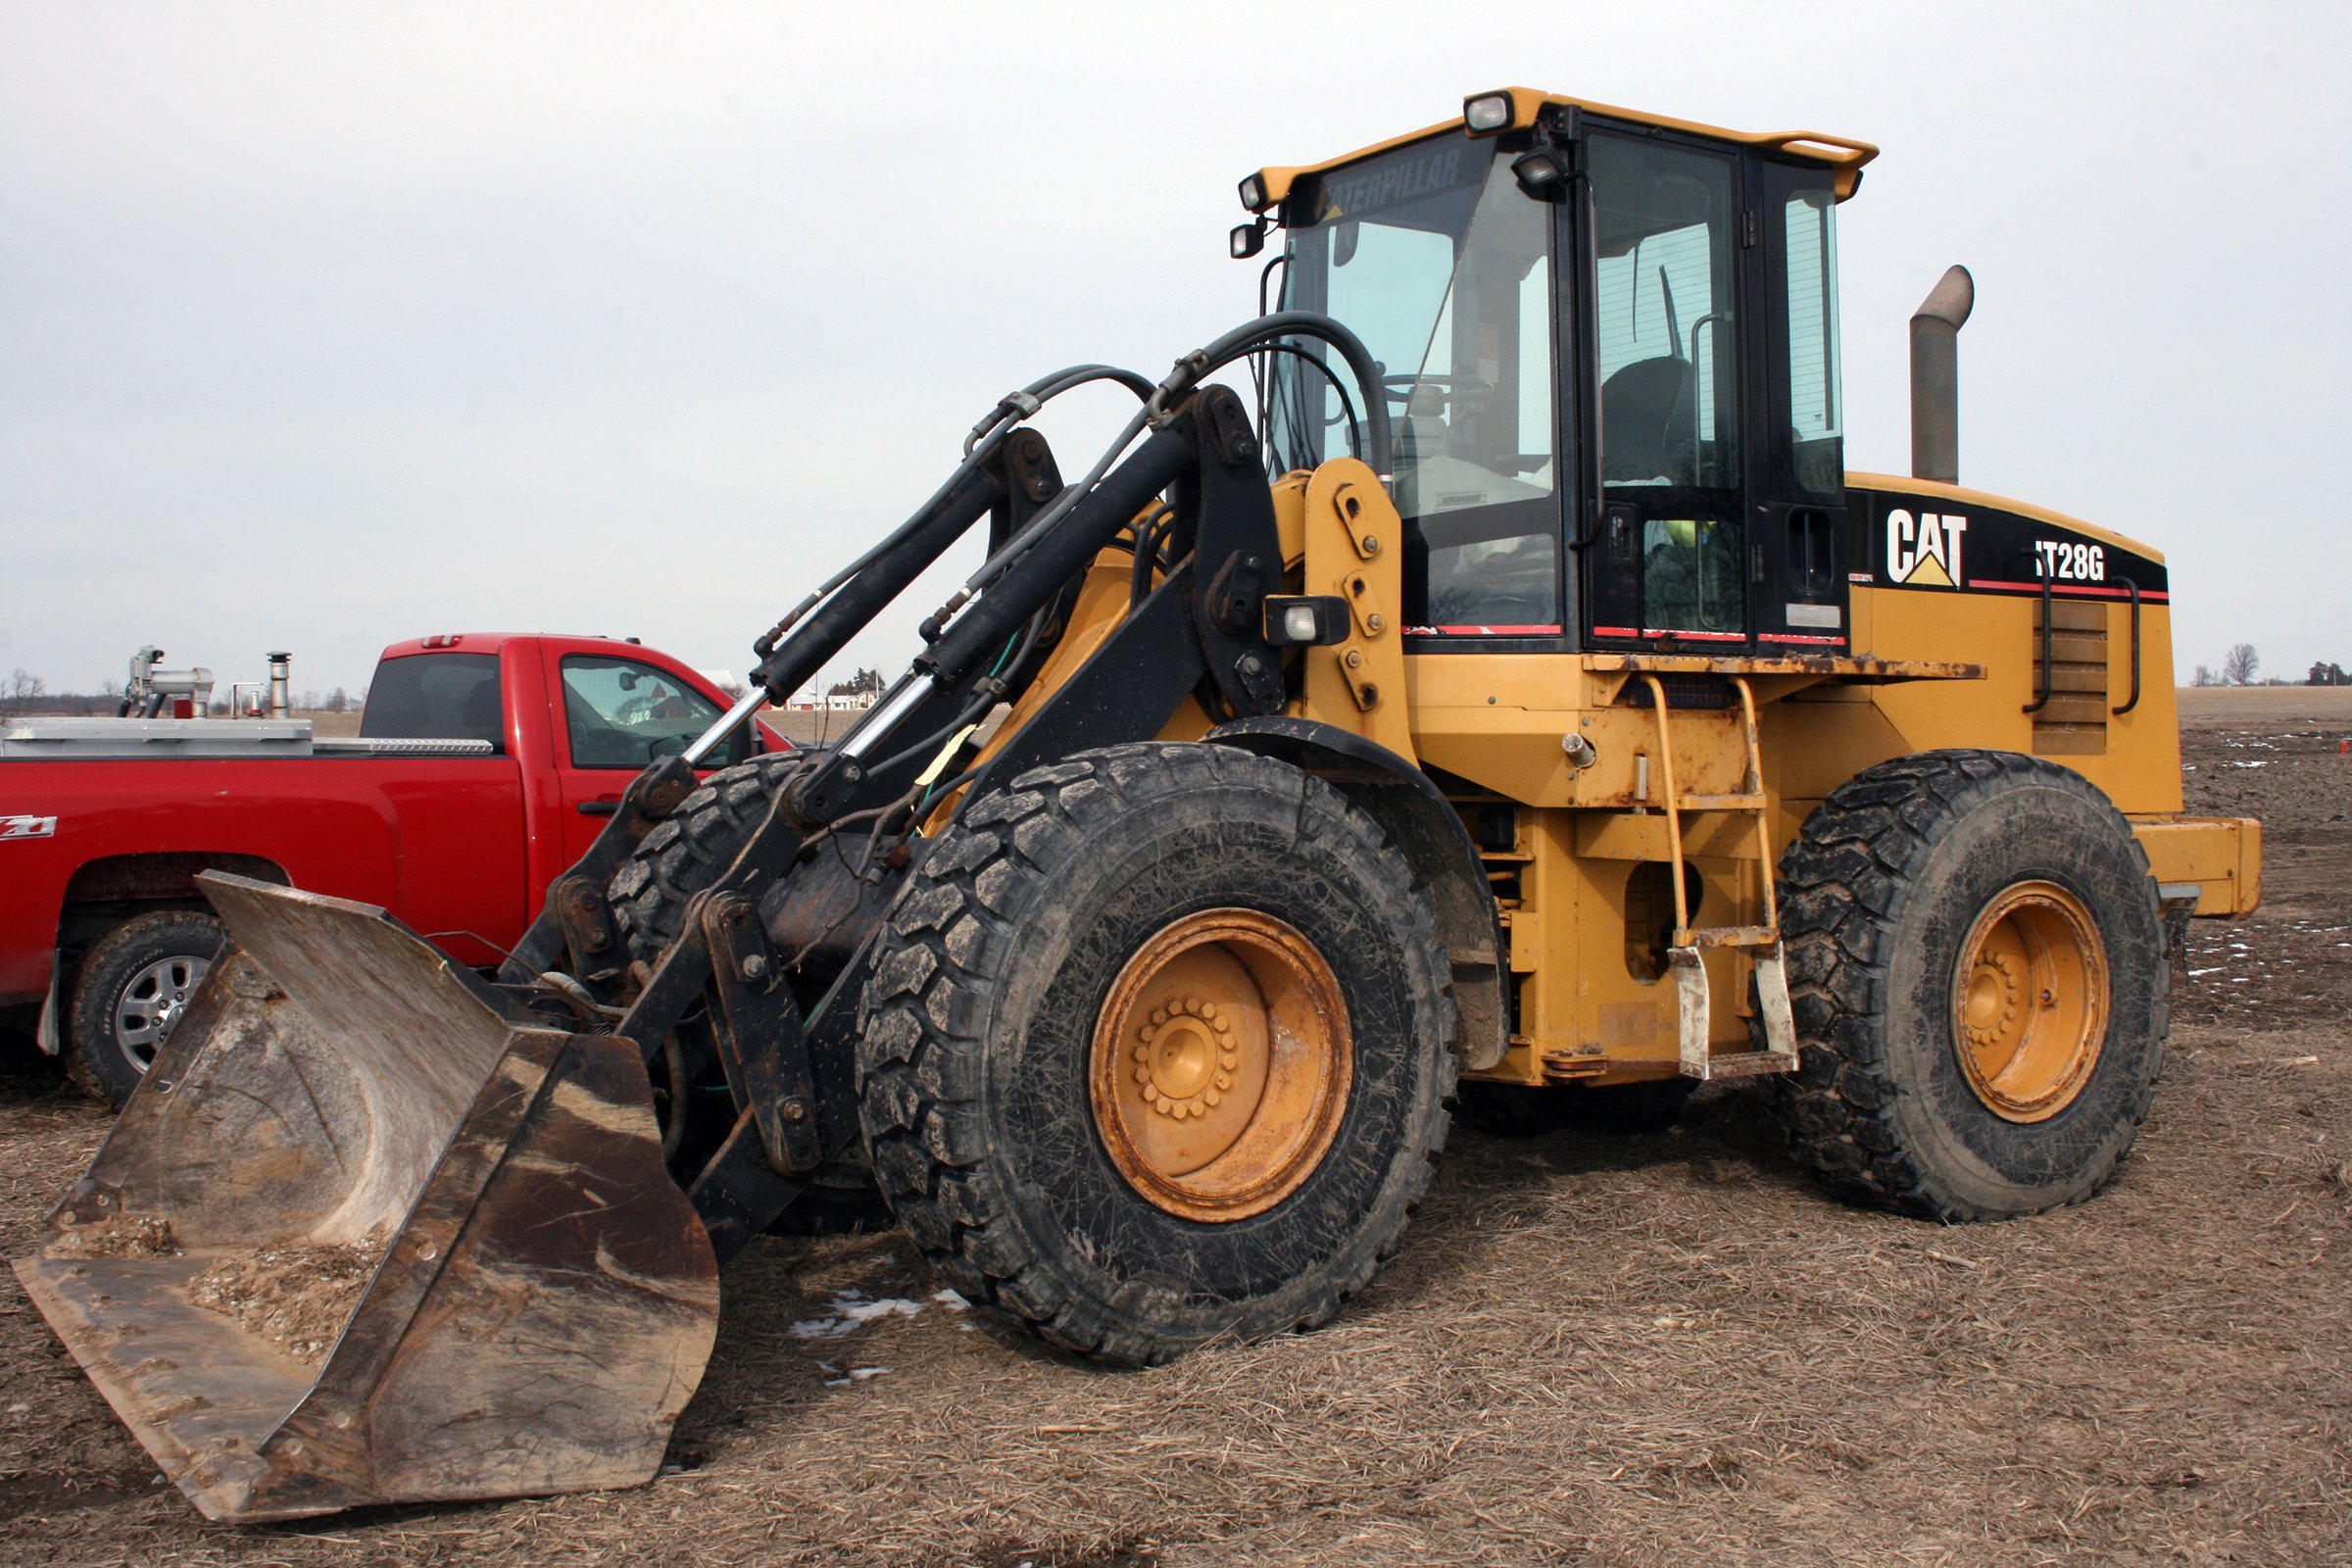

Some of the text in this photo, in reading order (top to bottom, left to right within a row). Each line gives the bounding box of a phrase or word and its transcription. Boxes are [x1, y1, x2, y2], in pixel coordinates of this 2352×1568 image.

[1328, 148, 1460, 215] ATERPILLAR
[1887, 509, 1967, 590] CAT
[2035, 540, 2104, 581] IT28G
